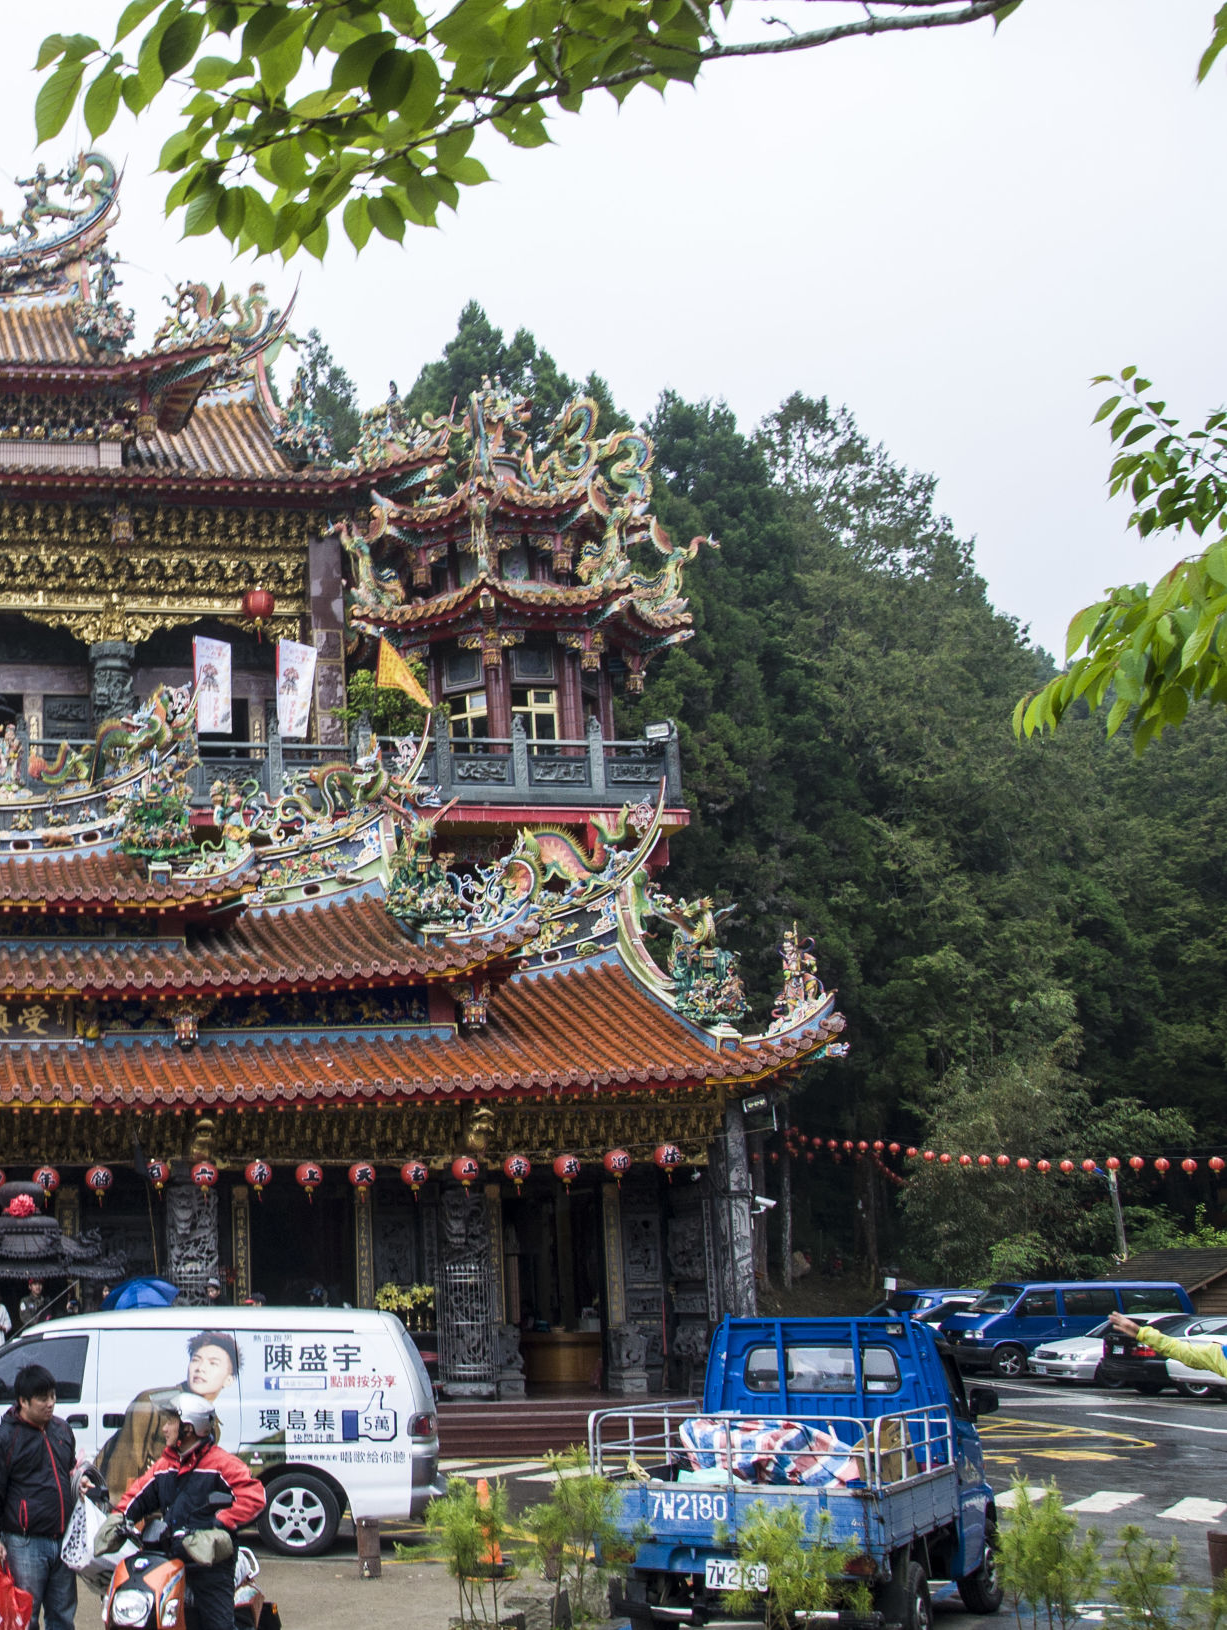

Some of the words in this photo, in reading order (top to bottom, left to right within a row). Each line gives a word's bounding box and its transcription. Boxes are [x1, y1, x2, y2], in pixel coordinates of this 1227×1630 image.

[264, 1344, 361, 1372] 陳盛宇
[330, 1376, 397, 1388] 點讚按分享
[259, 1409, 336, 1431] 環島集
[364, 1416, 390, 1431] 5萬
[649, 1491, 728, 1521] 7W2180
